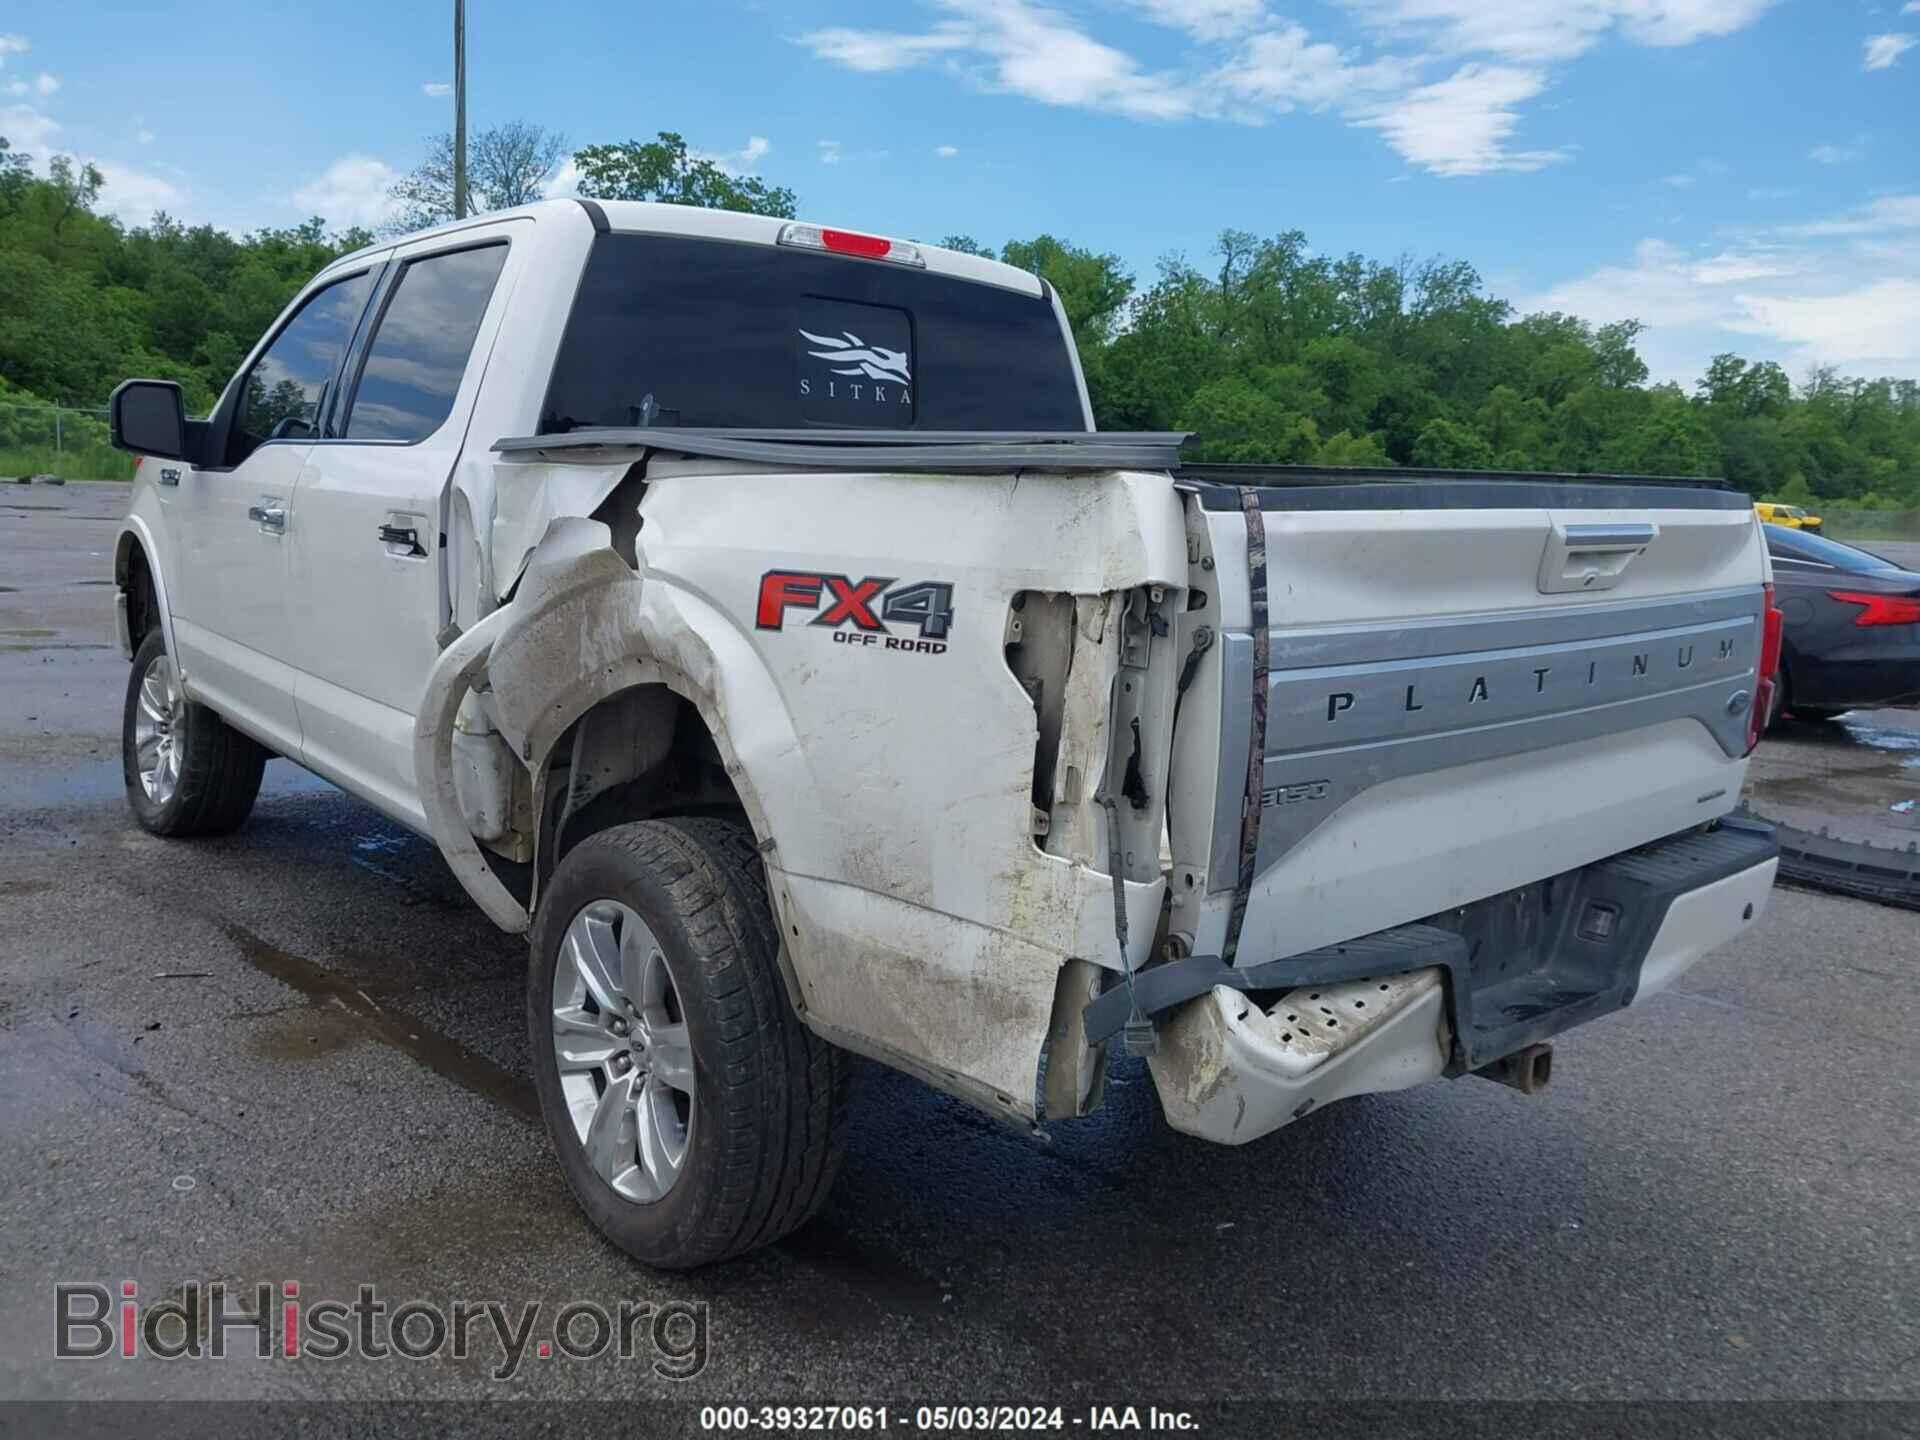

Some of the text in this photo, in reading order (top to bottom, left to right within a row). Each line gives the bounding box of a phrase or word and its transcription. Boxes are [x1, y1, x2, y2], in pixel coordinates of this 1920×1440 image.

[800, 379, 911, 404] SITKA
[755, 568, 955, 641] FX4
[833, 631, 947, 655] OFF ROAD
[1327, 638, 1734, 722] PLATINUM
